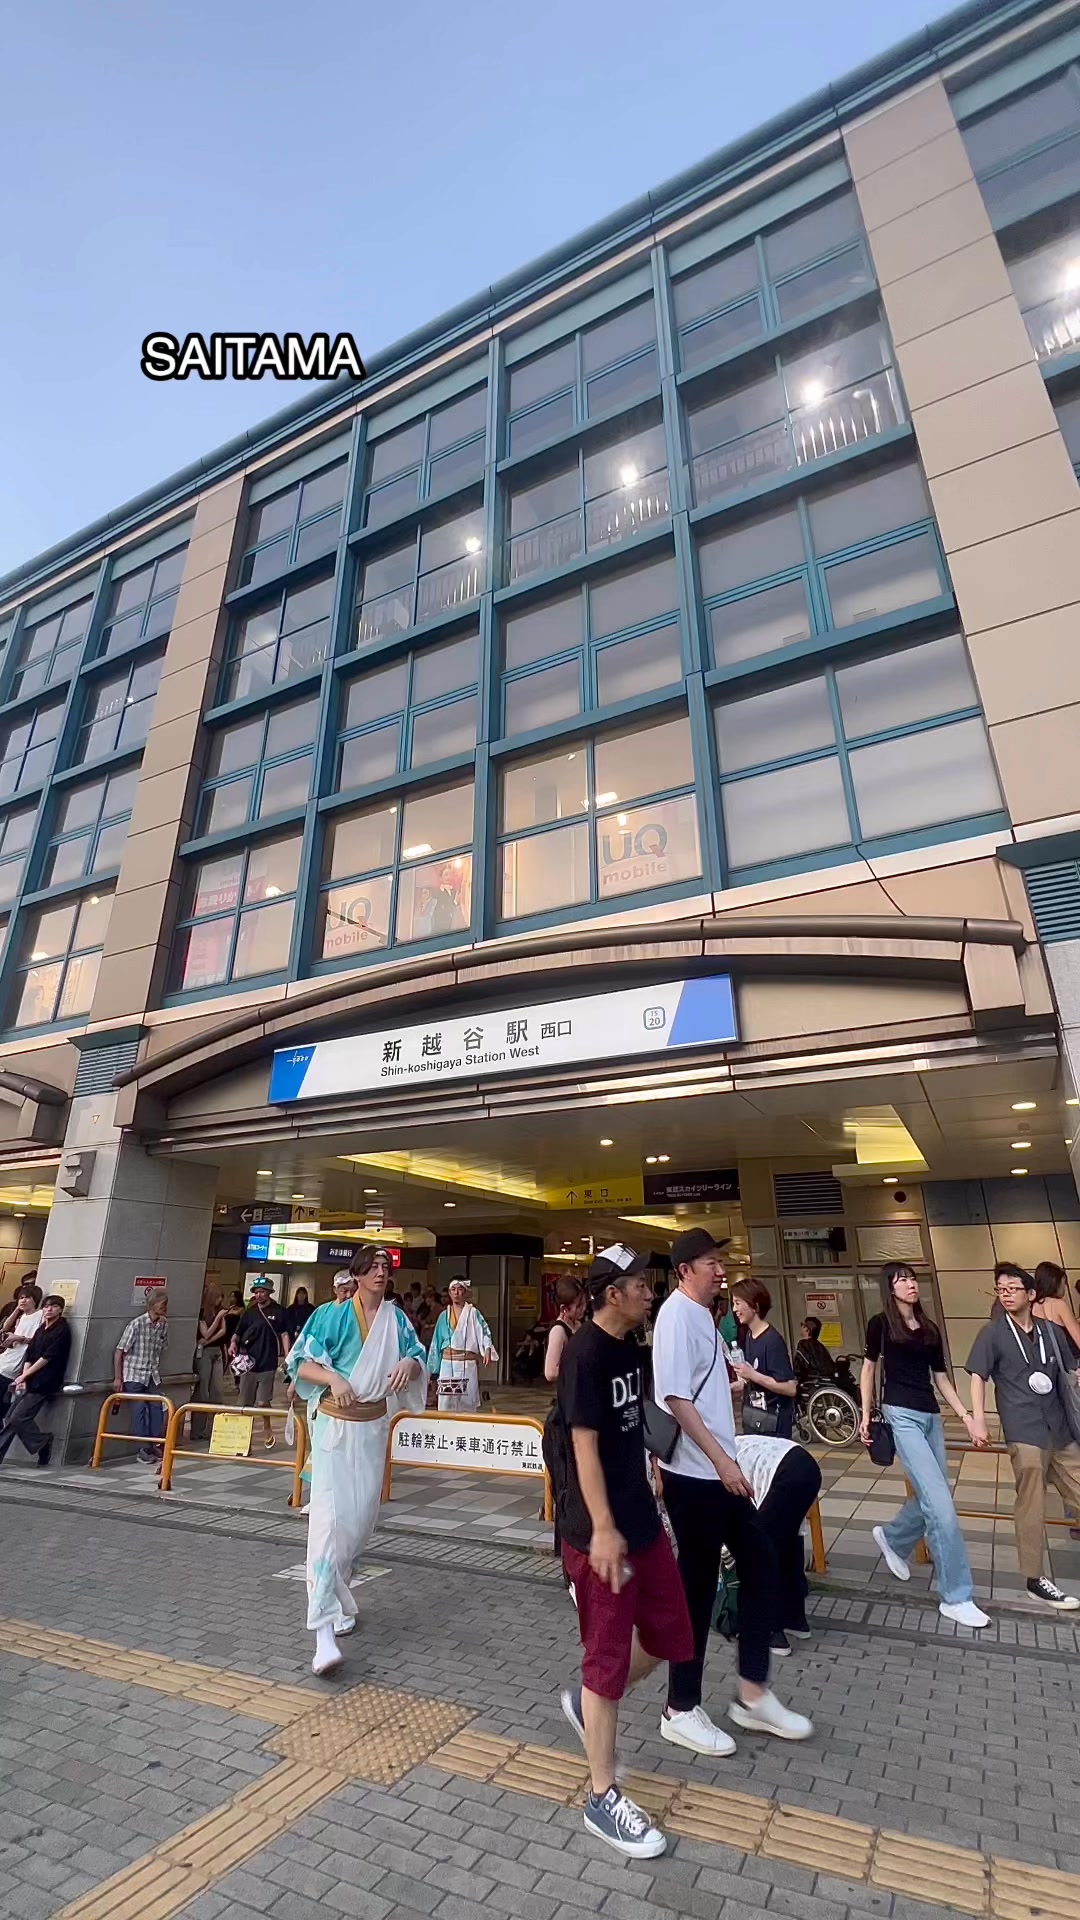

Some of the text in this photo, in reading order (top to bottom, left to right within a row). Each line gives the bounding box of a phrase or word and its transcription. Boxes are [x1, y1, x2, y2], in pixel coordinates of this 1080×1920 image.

[602, 823, 668, 865] UQ
[602, 861, 667, 885] mobile
[649, 1017, 661, 1026] 20
[382, 1019, 572, 1064] 新越谷駅 西口
[380, 1045, 540, 1077] Shin-koshigaya Station West
